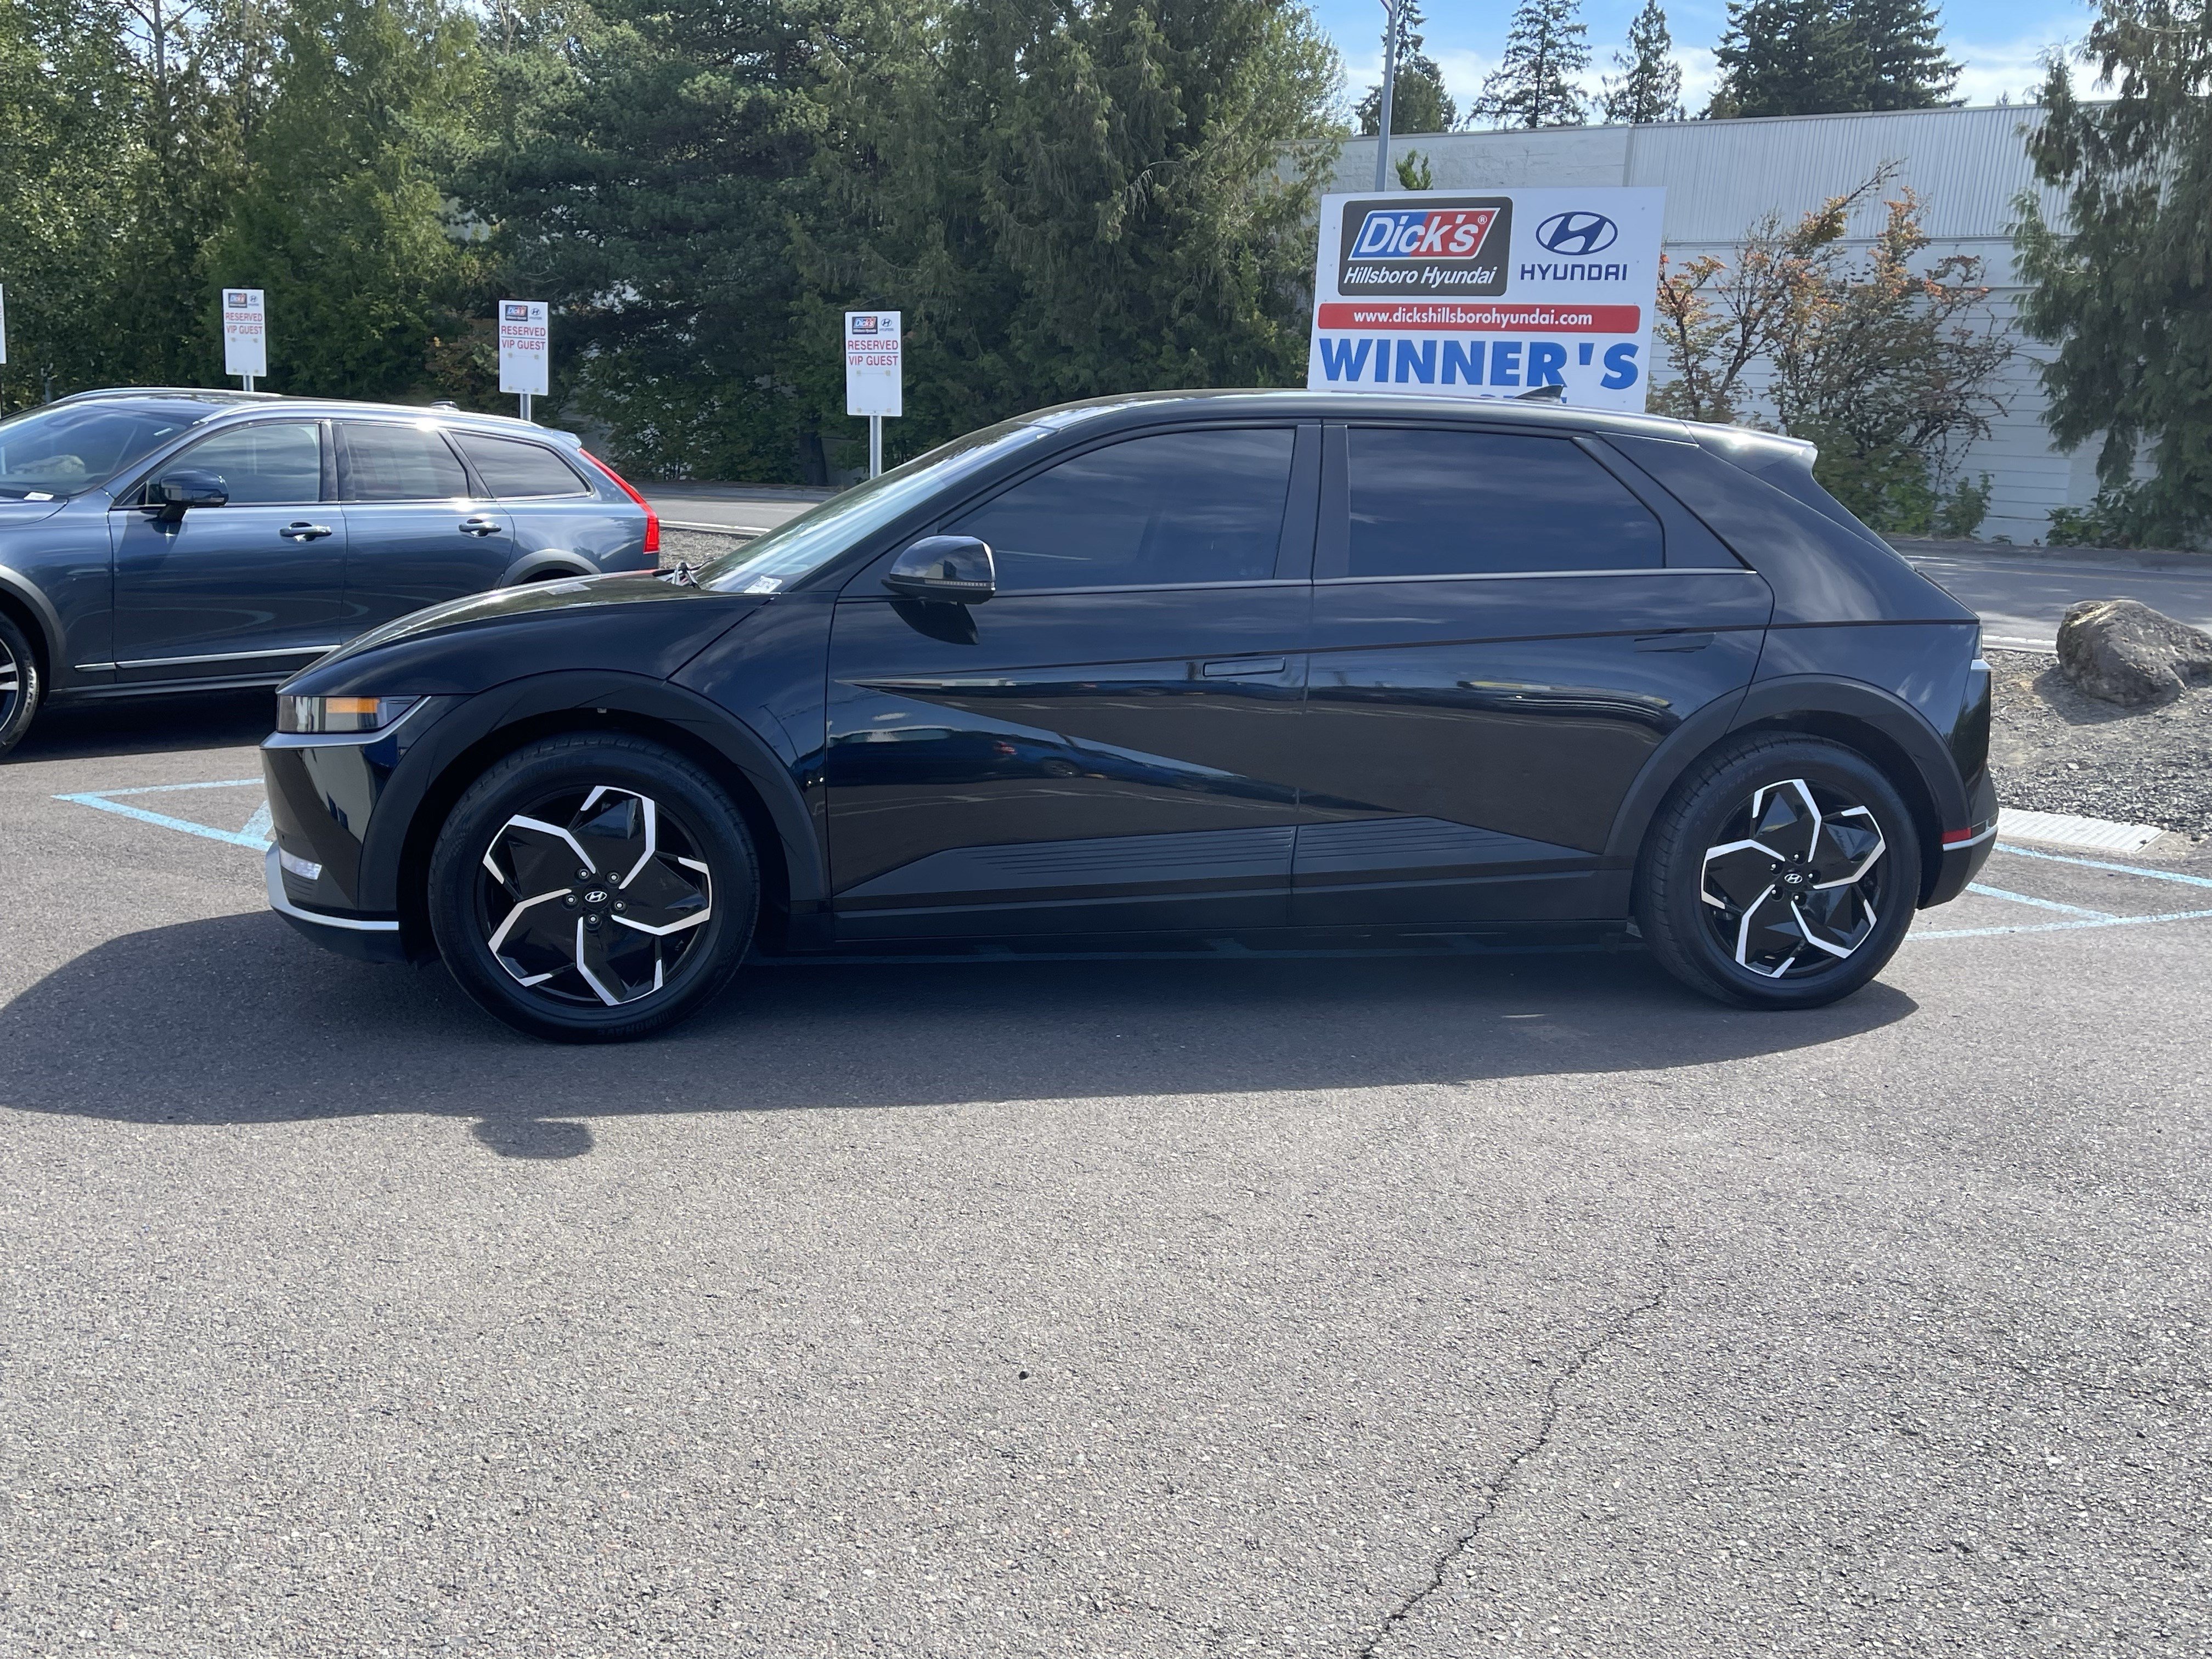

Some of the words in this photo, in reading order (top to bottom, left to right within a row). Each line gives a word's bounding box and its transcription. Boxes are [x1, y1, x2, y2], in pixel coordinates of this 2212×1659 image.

[1359, 214, 1479, 253] Dick's
[1344, 267, 1418, 284] Hillsboro
[1421, 266, 1498, 288] Hyundai
[1520, 264, 1628, 280] HYUNDAI
[225, 312, 263, 322] RESERVED
[1353, 307, 1592, 328] www.dickshillsborohyundai.com
[226, 325, 237, 333] VIP
[239, 325, 263, 334] GUEST
[501, 326, 546, 336] RESERVED
[502, 340, 515, 348] VIP
[517, 340, 546, 351] GUEST
[848, 340, 898, 350] RESERVED
[849, 356, 863, 365] VIP
[866, 356, 898, 365] GUEST
[1319, 338, 1639, 390] WINNER'S
